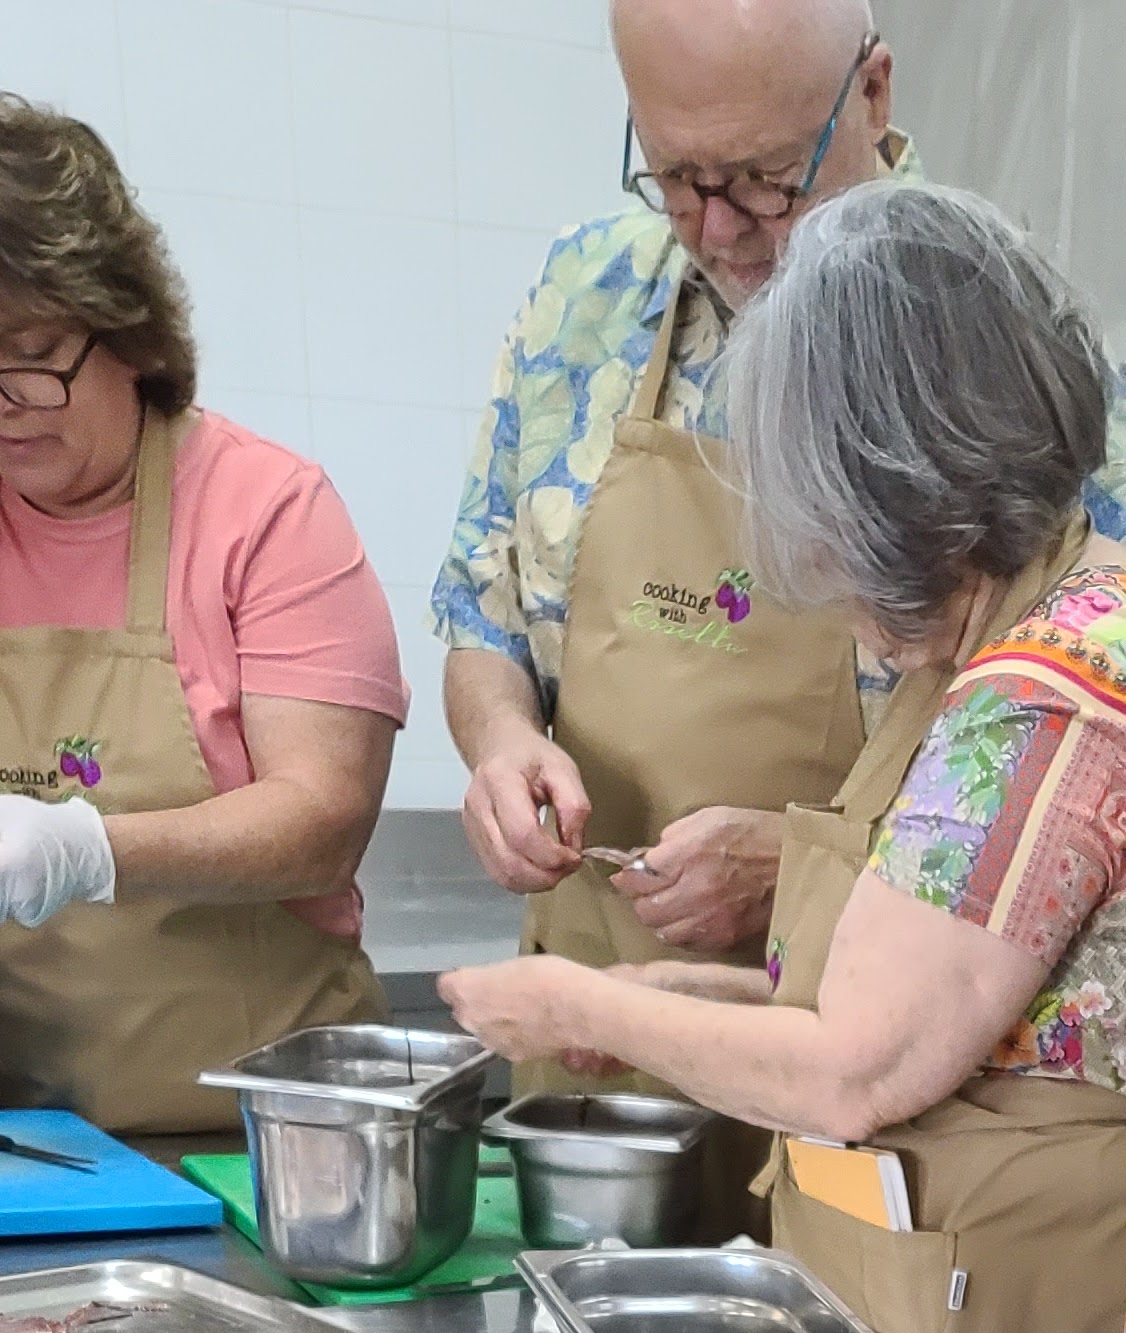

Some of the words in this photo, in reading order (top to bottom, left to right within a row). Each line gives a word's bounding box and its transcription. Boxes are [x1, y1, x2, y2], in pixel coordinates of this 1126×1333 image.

[643, 582, 711, 614] cooking
[659, 607, 687, 624] with
[0, 766, 59, 789] ooking
